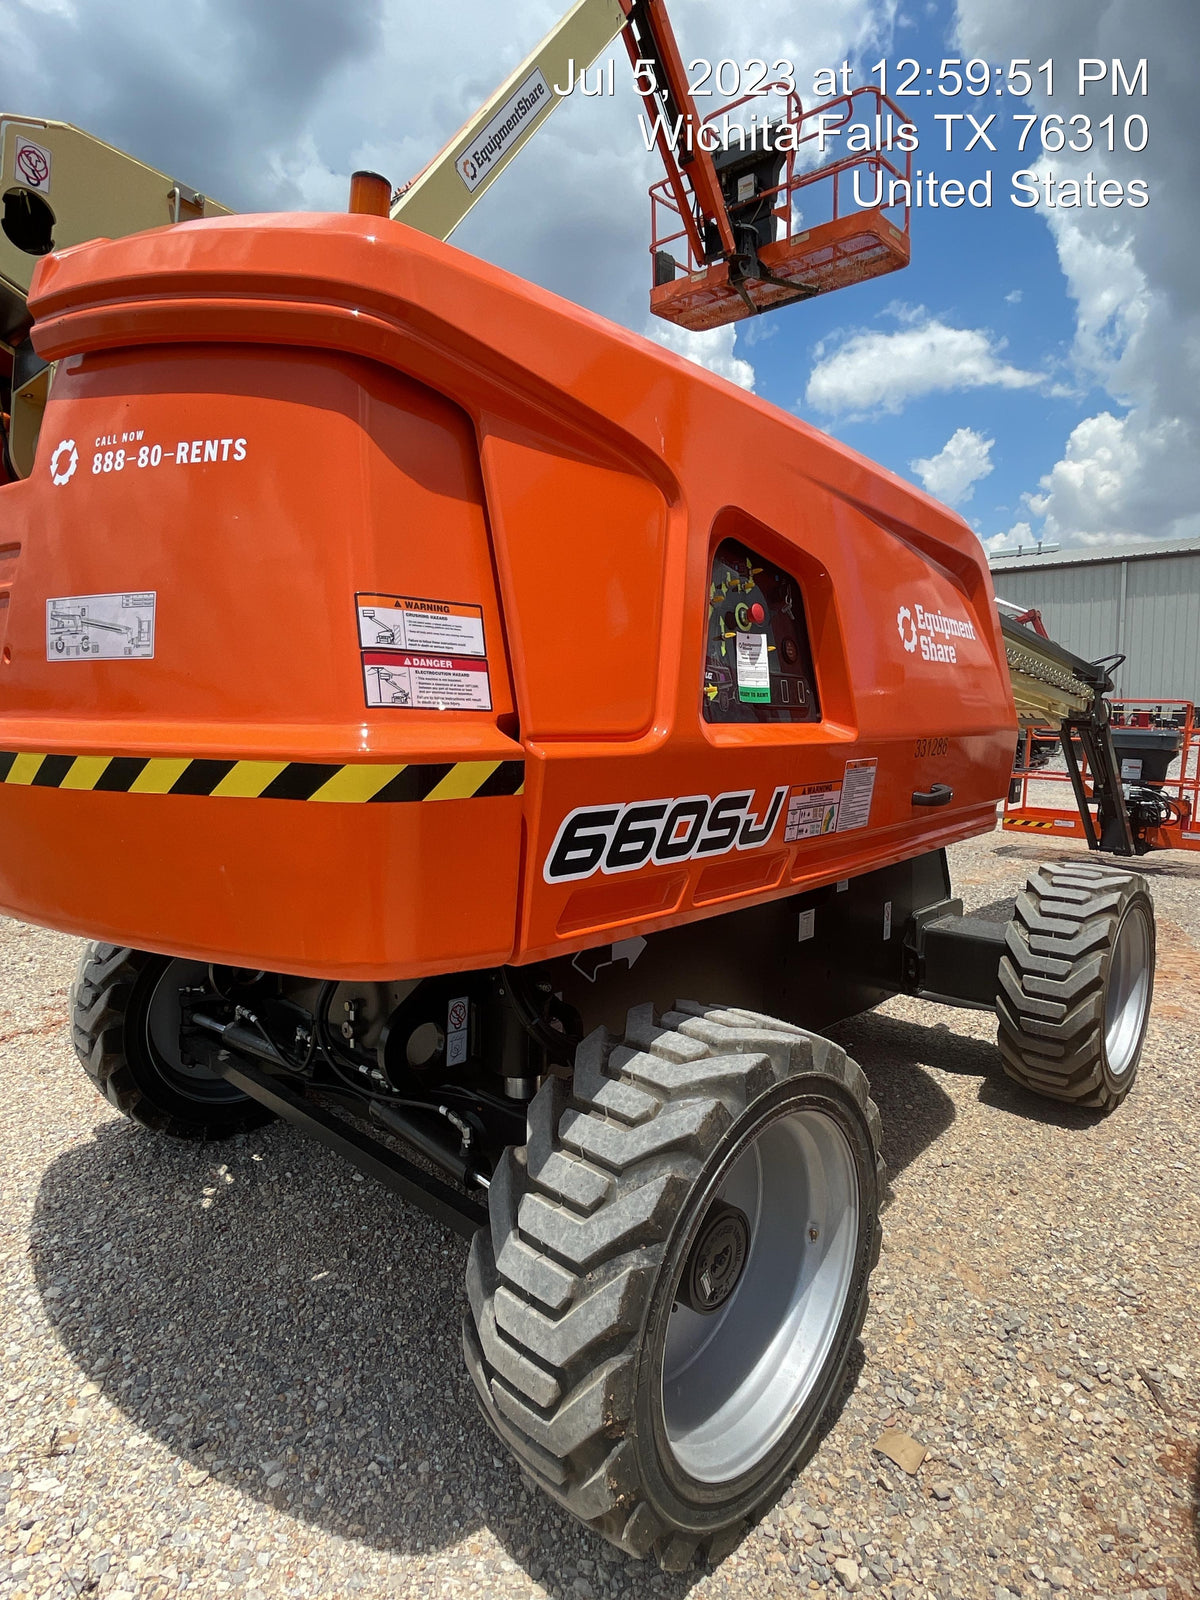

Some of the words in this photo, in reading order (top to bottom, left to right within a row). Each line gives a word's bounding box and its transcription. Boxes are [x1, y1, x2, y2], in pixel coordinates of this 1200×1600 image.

[472, 83, 545, 168] EquipmentShare
[95, 435, 117, 447] CALL
[122, 430, 144, 443] NOW
[92, 438, 248, 475] 888-80-RENTS
[405, 602, 450, 613] WARNING
[914, 604, 976, 640] Equipment
[413, 658, 453, 669] DANGER
[920, 636, 957, 664] Share
[914, 737, 949, 758] 331286
[543, 785, 789, 885] 660SJ
